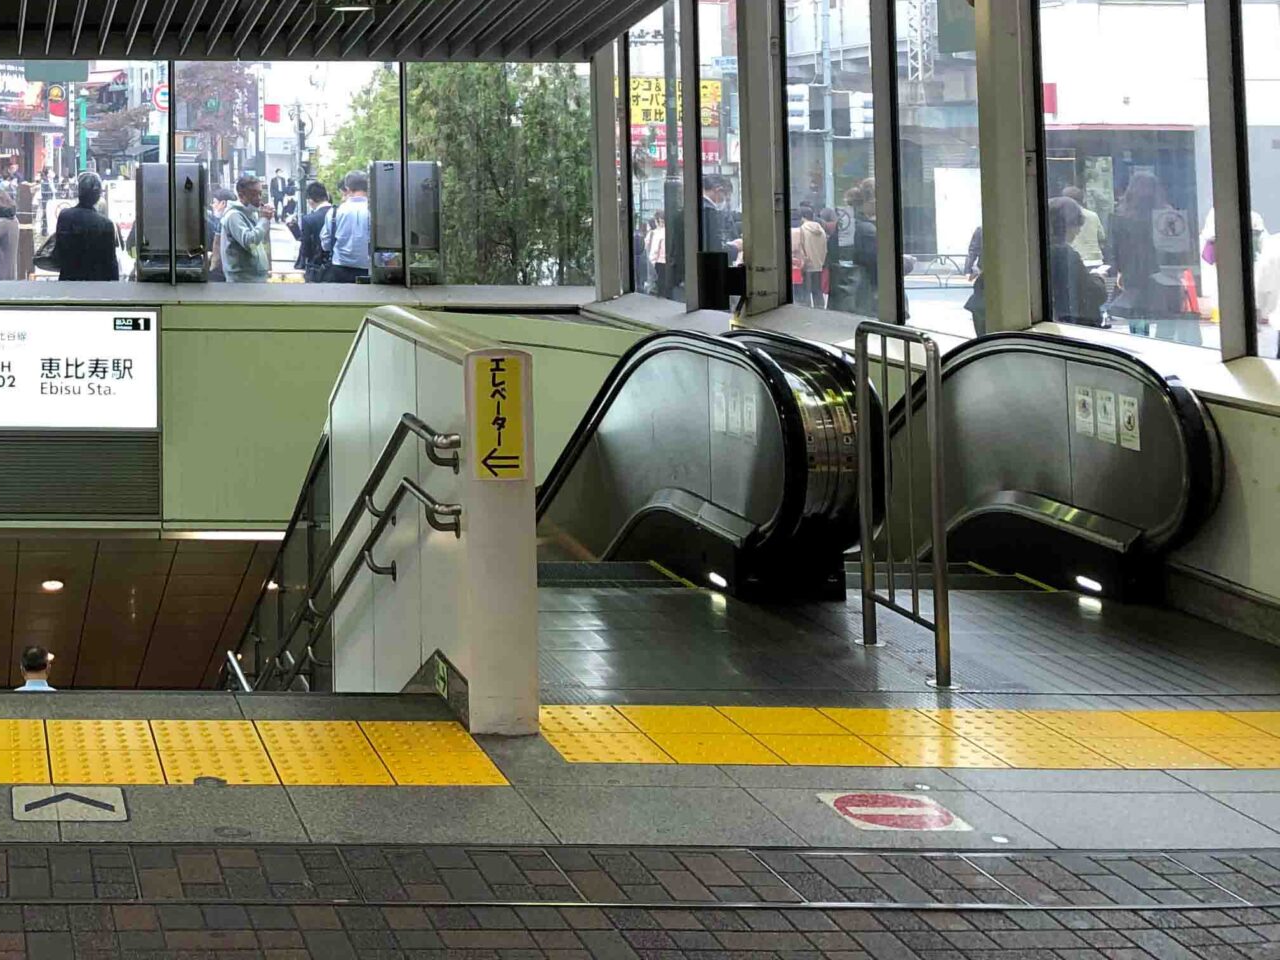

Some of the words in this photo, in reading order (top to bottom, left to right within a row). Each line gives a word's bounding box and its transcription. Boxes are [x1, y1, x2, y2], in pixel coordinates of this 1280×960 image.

[137, 318, 145, 330] 1
[1, 361, 11, 372] H
[40, 357, 133, 380] 恵比寿駅
[40, 382, 81, 395] Ebisu
[88, 382, 116, 395] Sta.
[490, 358, 507, 447] エレベーター
